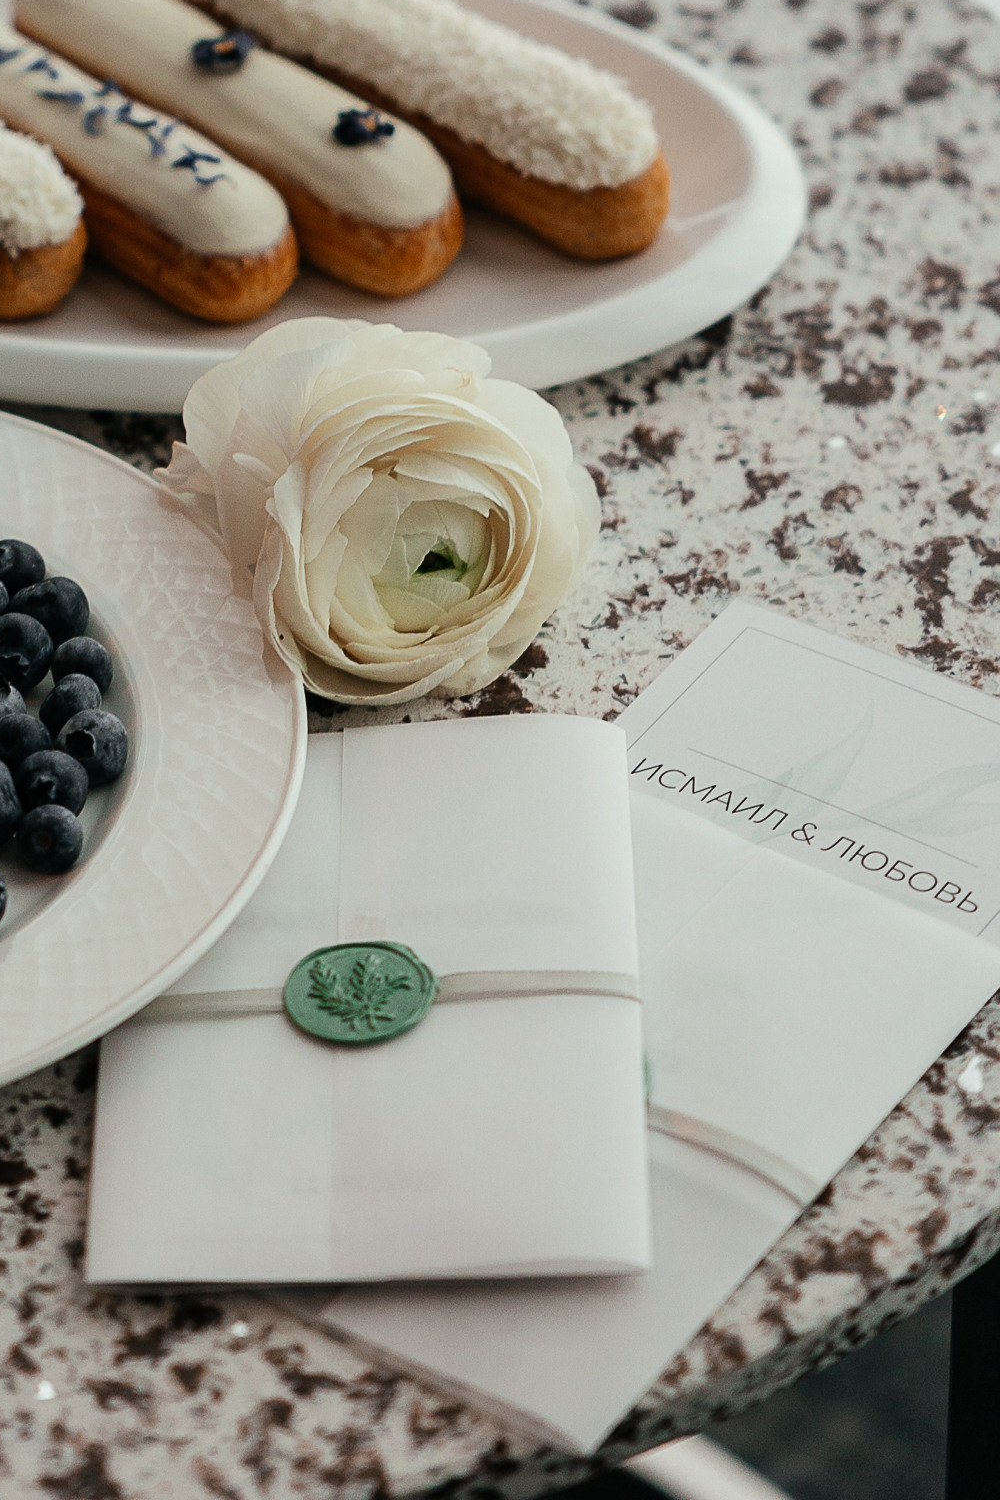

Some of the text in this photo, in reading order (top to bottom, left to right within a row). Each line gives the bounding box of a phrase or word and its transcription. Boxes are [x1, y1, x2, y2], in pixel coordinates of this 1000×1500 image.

[631, 757, 979, 914] ИСМАИЛ & ЛЮБОВЬ
